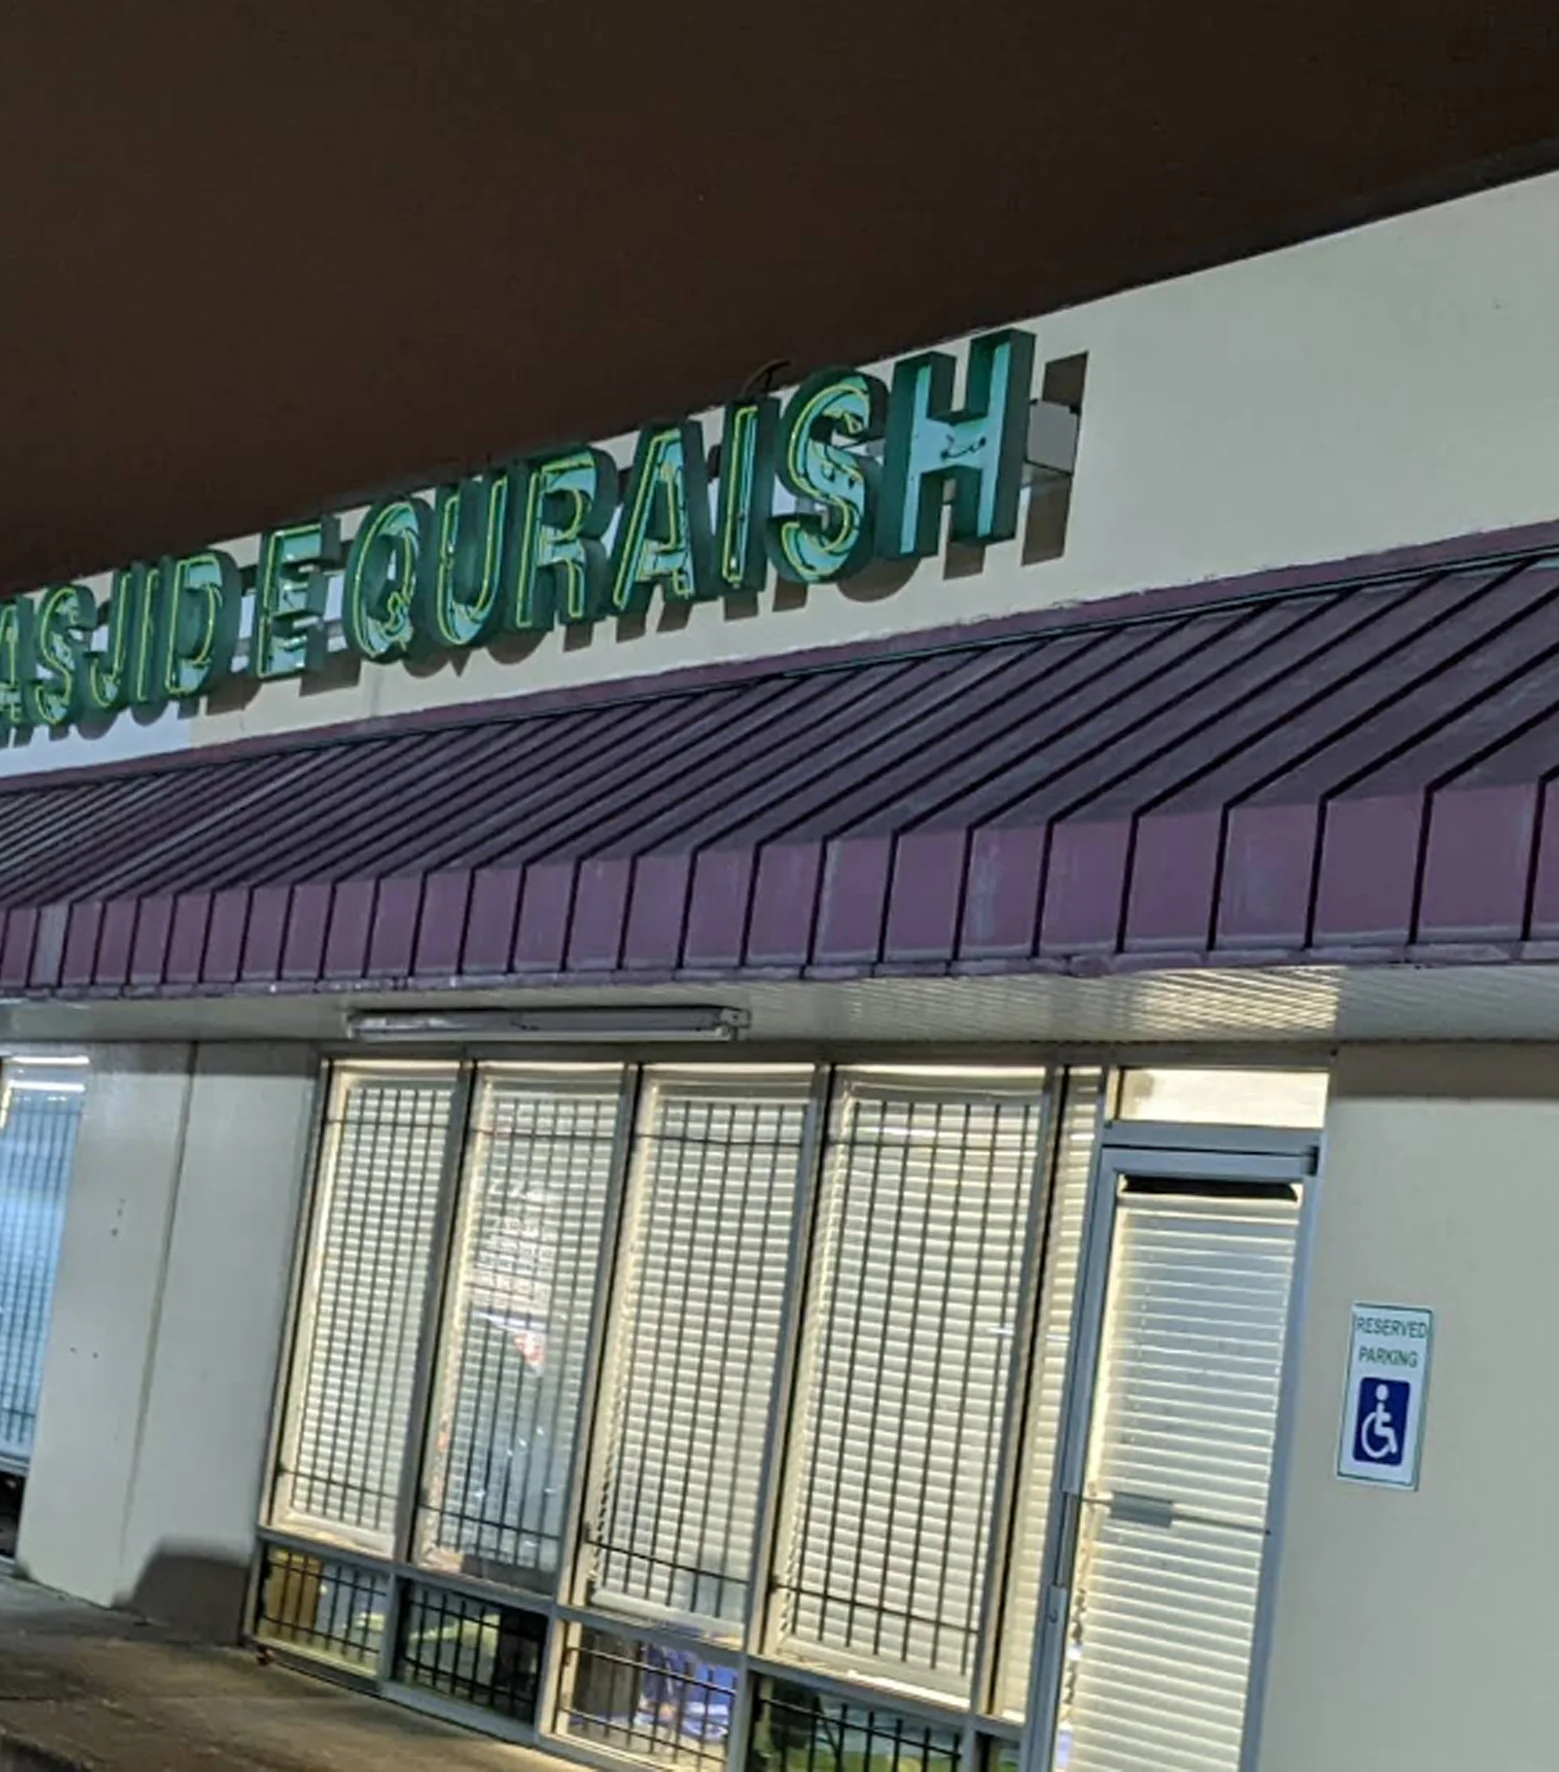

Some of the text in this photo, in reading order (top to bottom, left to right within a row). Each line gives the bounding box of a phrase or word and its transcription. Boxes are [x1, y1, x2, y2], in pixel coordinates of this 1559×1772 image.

[255, 511, 341, 682] E
[343, 328, 1036, 665] QURAISH
[1357, 1317, 1428, 1338] RESERVED
[1359, 1346, 1418, 1367] PARKING
